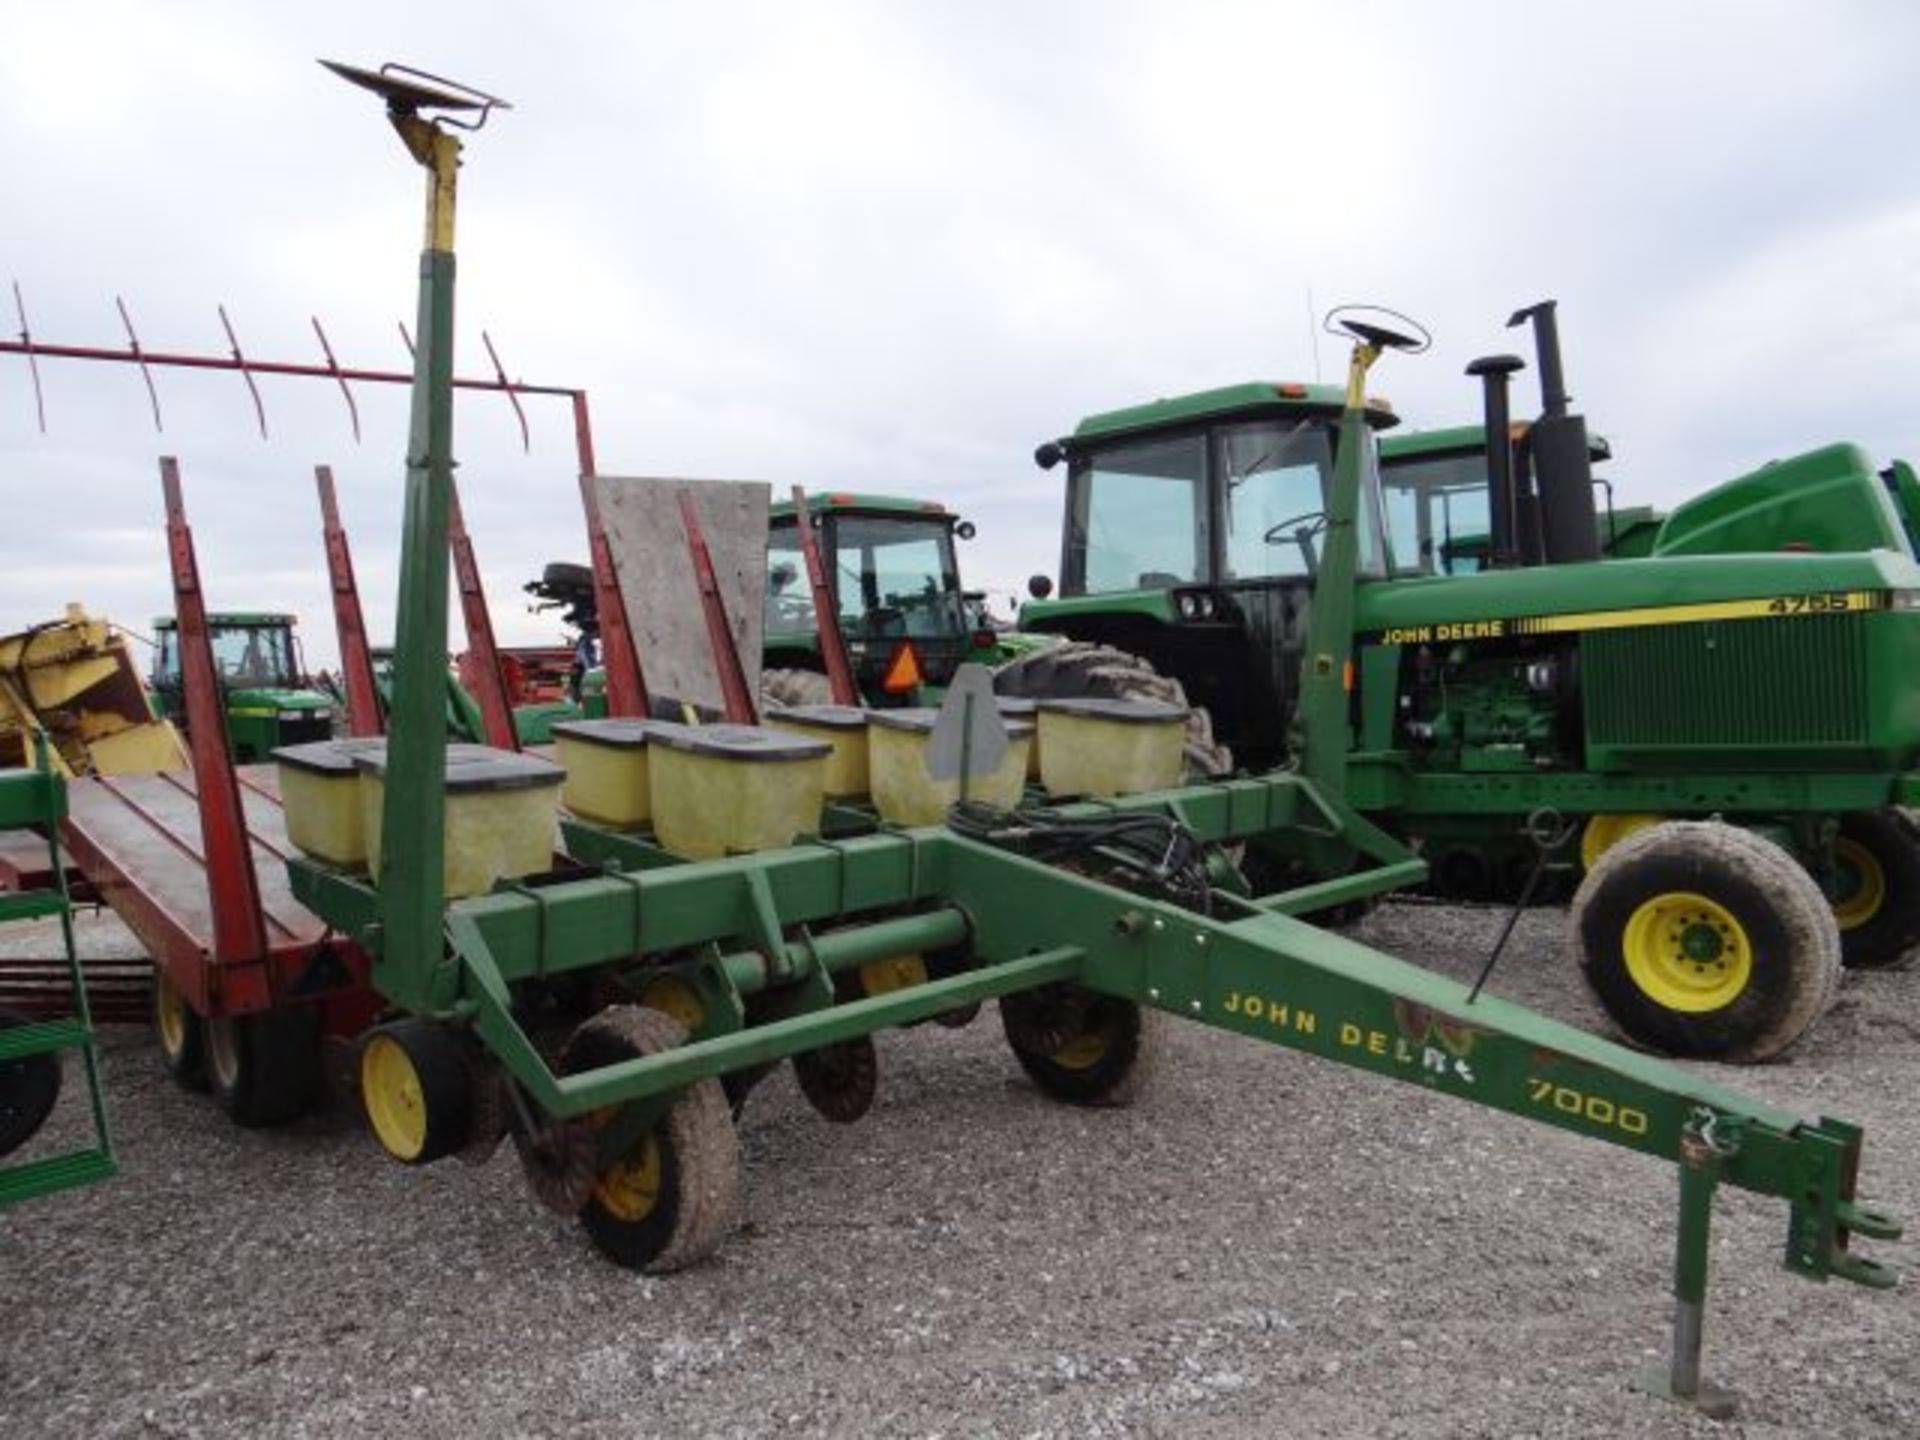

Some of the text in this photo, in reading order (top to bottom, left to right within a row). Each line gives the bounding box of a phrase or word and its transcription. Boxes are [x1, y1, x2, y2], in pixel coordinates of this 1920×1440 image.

[1382, 620, 1503, 646] JOHN DEERE
[1224, 992, 1316, 1034] JOHN
[1529, 1078, 1648, 1134] 7000
